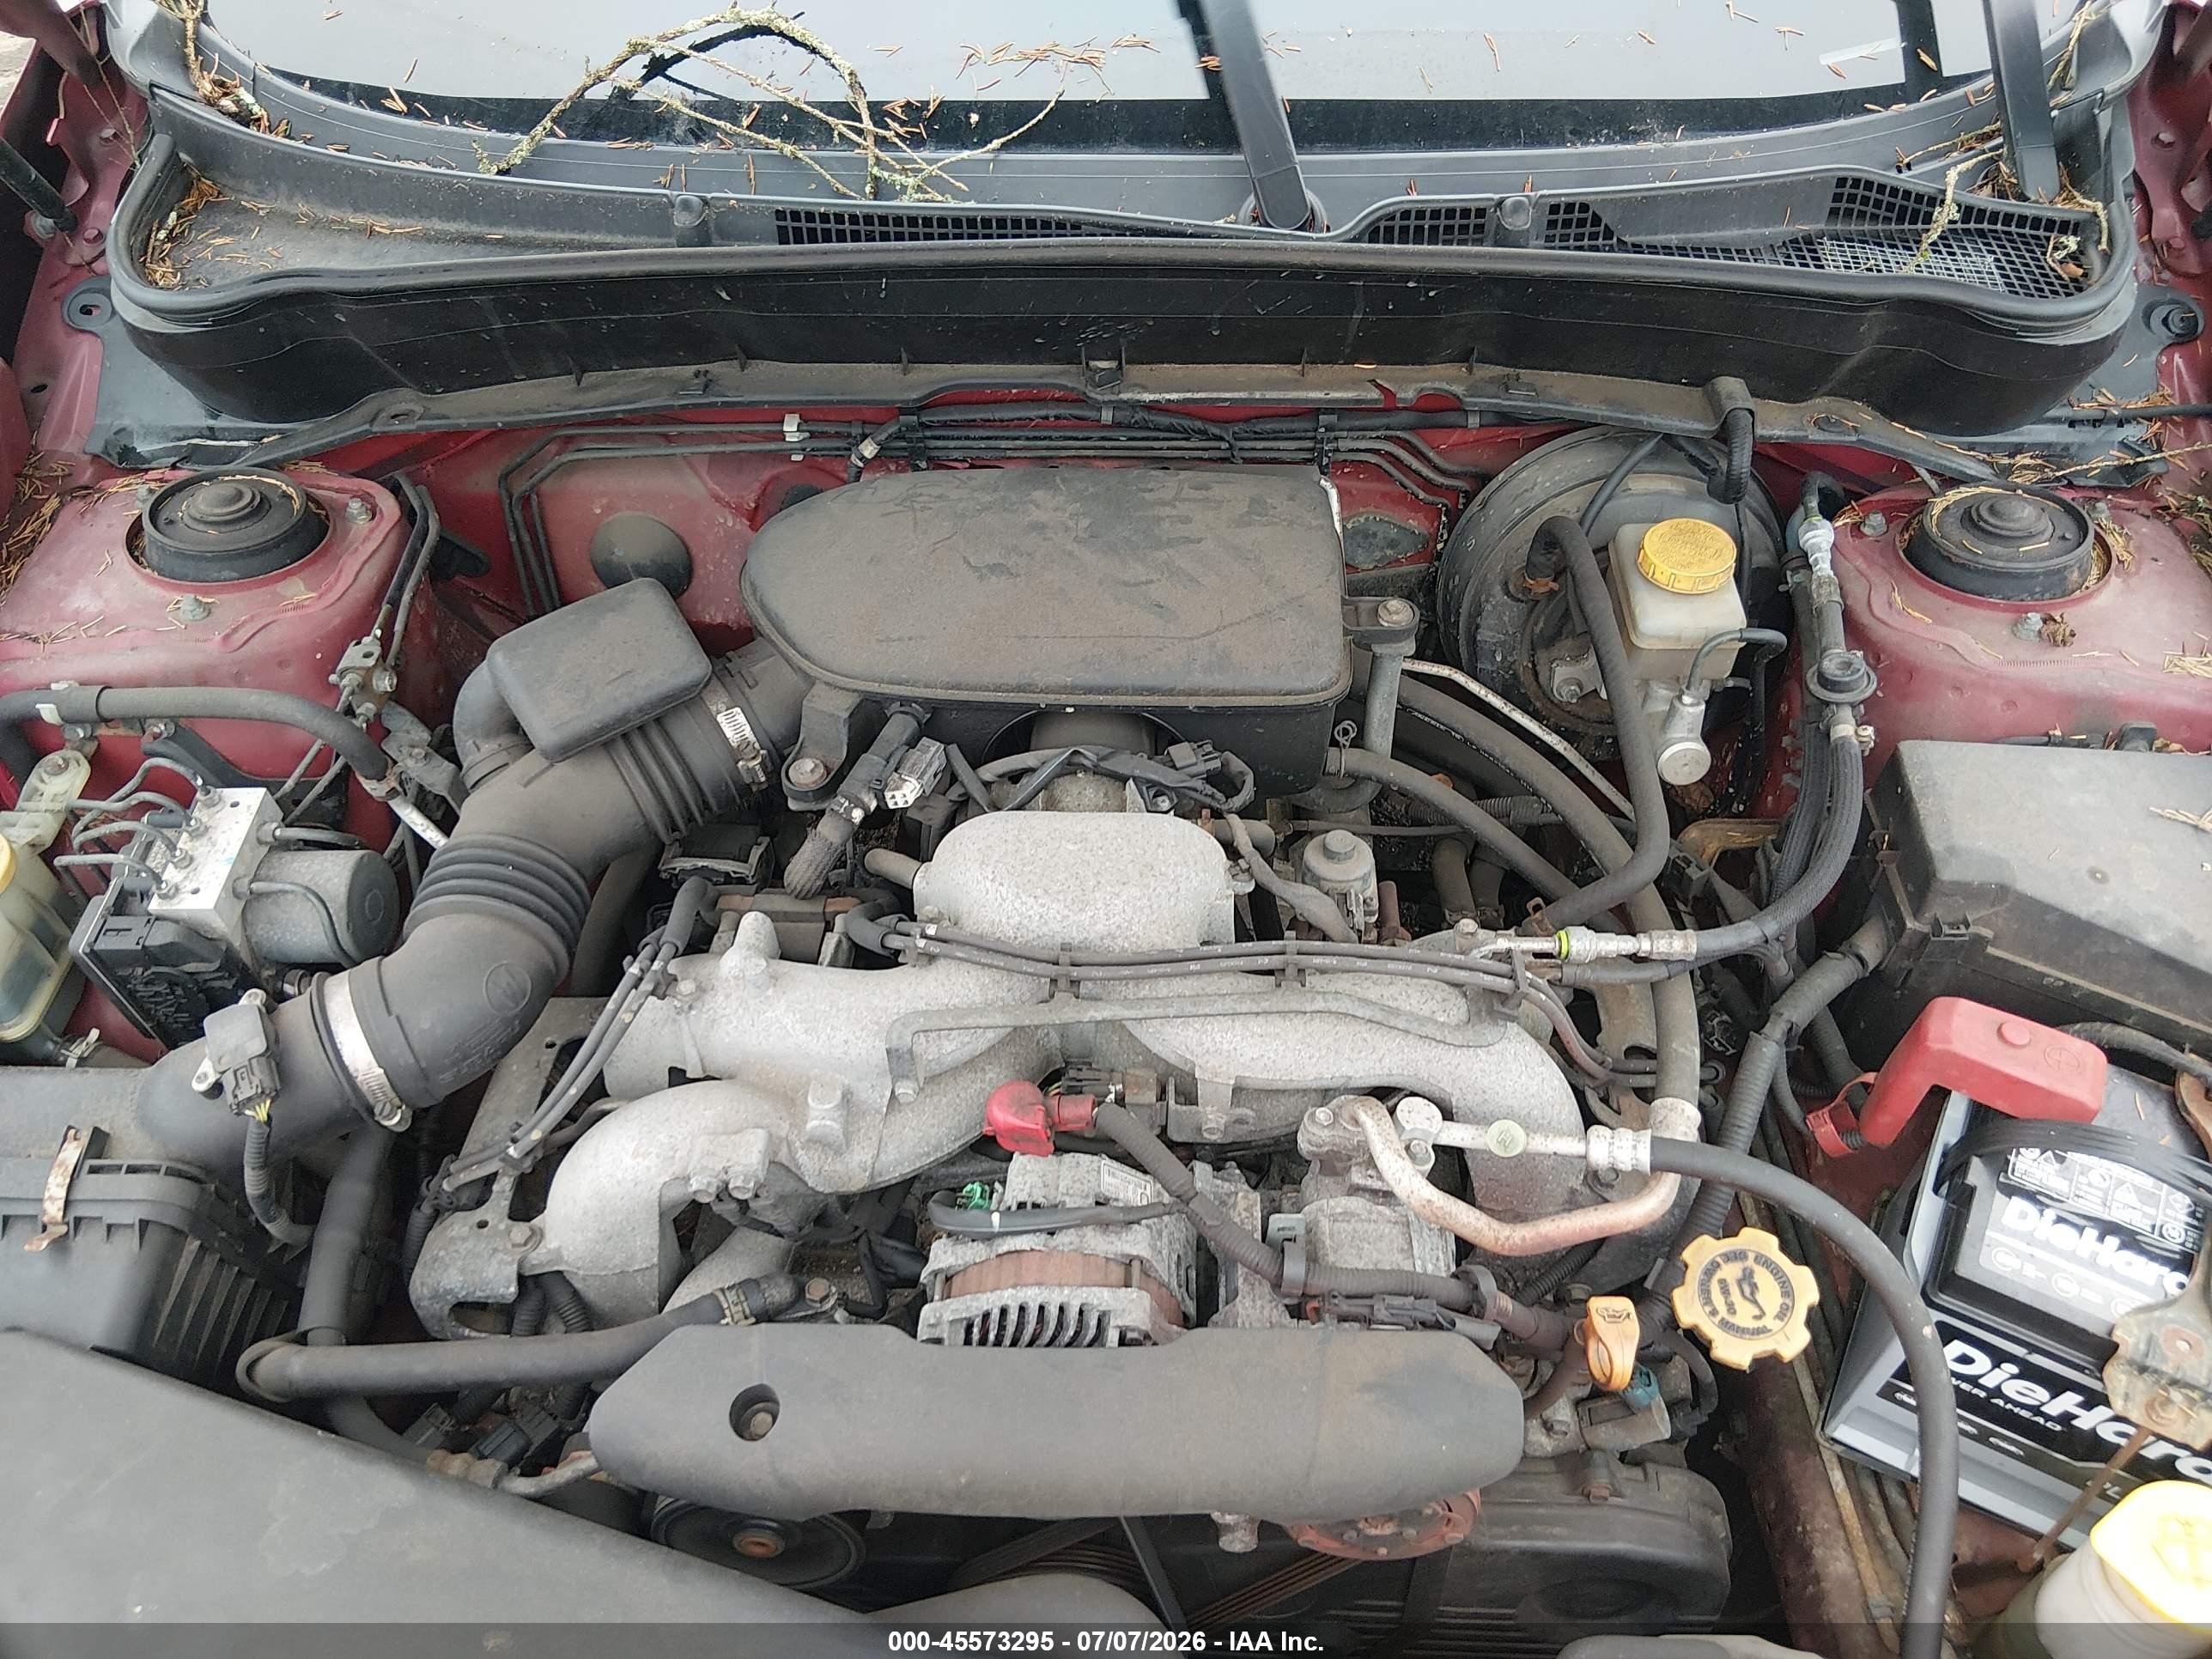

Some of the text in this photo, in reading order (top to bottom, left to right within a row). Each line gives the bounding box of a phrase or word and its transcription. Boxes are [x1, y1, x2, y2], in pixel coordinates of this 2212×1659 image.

[1753, 1253, 1790, 1322] ENGINE OIL
[1990, 1398, 2063, 1432] AHEAD
